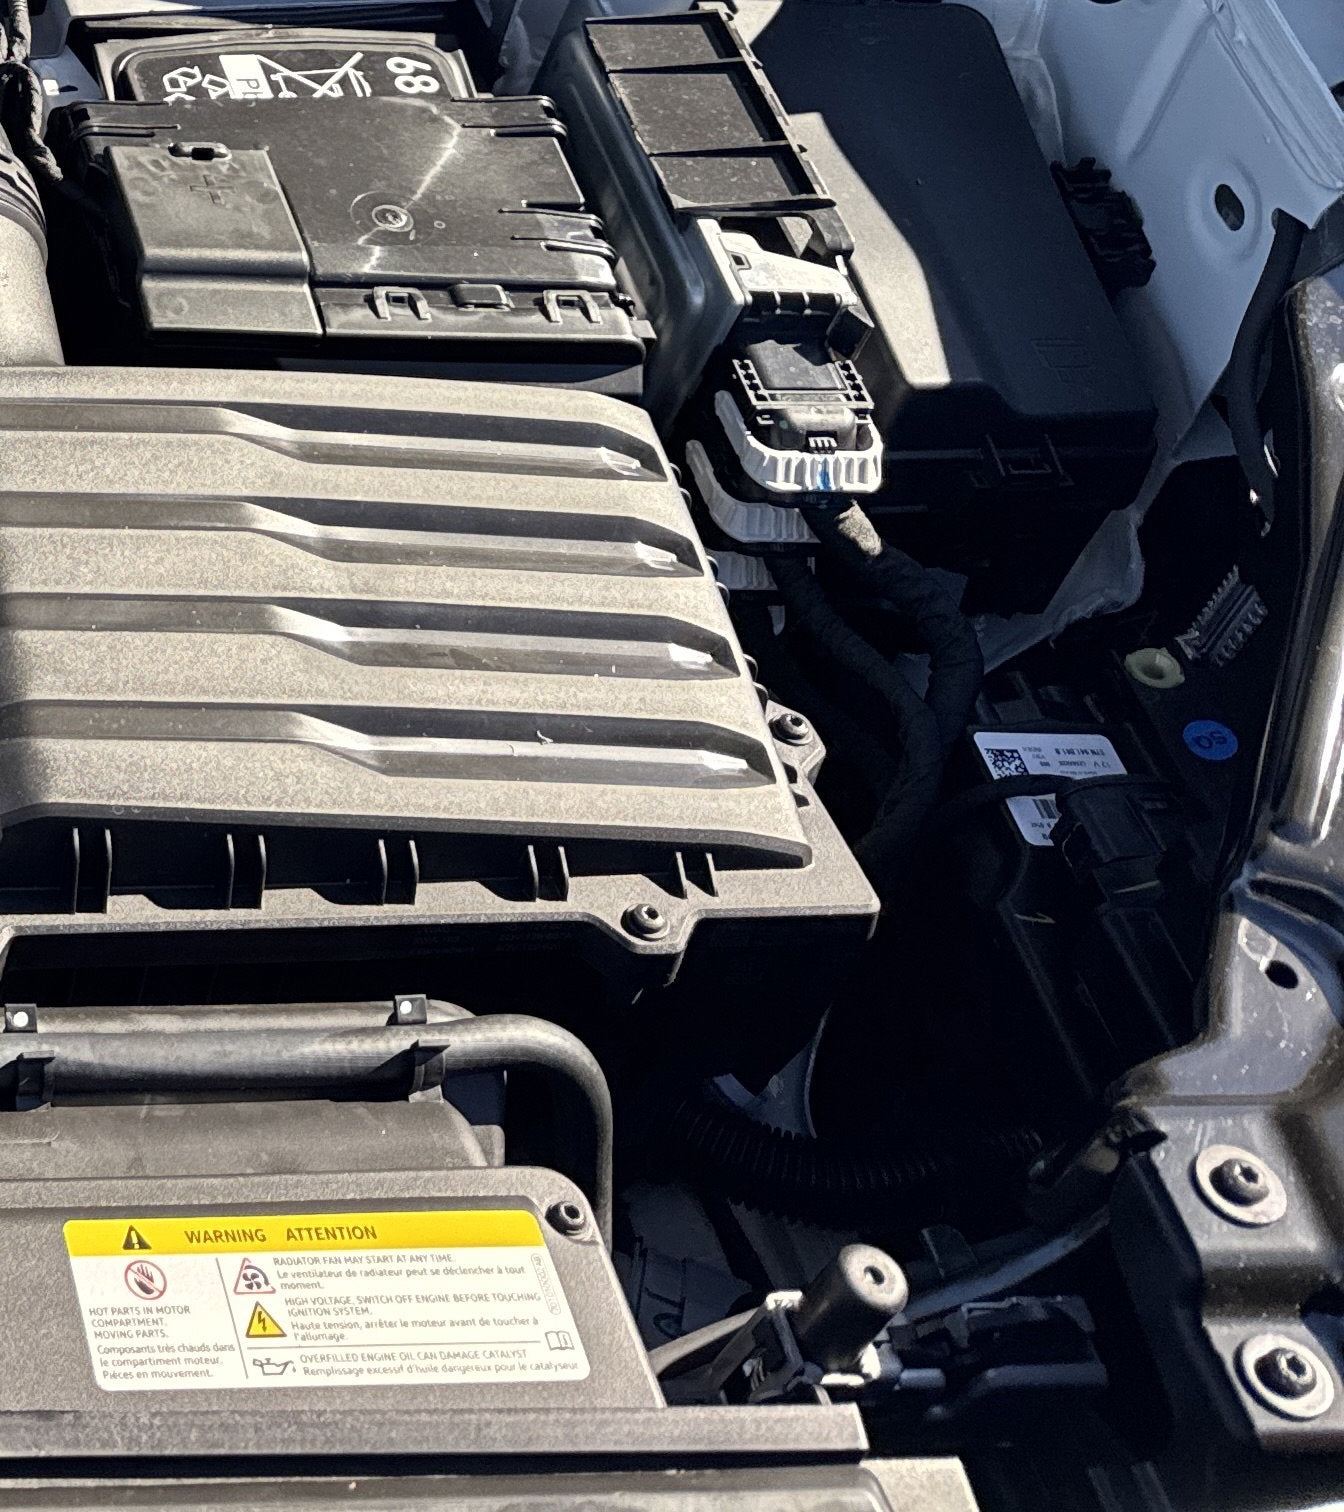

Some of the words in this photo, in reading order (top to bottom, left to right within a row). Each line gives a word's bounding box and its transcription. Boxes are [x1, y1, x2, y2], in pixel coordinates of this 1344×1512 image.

[184, 1226, 267, 1244] WARNING
[286, 1225, 378, 1242] ATTENTION
[273, 1256, 320, 1266] RADIATOR
[322, 1256, 342, 1264] FAN
[344, 1256, 363, 1264] MAY
[366, 1255, 393, 1264] START
[396, 1254, 407, 1263] AT
[409, 1254, 428, 1263] ANY
[277, 1270, 288, 1278] Le
[292, 1269, 342, 1278] ventilateur
[345, 1269, 357, 1278] de
[360, 1268, 402, 1278] radiateur
[406, 1267, 427, 1277] peut
[443, 1266, 494, 1275] déclencher
[497, 1266, 503, 1274] à
[505, 1266, 526, 1274] tout
[280, 1281, 324, 1290] moment.
[285, 1297, 309, 1306] HIGH
[356, 1295, 392, 1304] SWITCH
[395, 1295, 413, 1304] OFF
[416, 1295, 450, 1304] ENGINE
[453, 1293, 490, 1303] BEFORE
[492, 1292, 541, 1302] TOUCHING
[89, 1307, 109, 1316] HOT
[112, 1306, 141, 1315] PARTS
[143, 1306, 154, 1315] IN
[156, 1305, 191, 1315] MOTOR
[288, 1308, 331, 1317] IGNITION
[333, 1307, 373, 1316] SYSTEM.
[91, 1317, 168, 1328] COMPARTMENT.
[291, 1322, 321, 1330] Haute
[323, 1320, 363, 1330] tension,
[364, 1319, 398, 1329] arrêter
[400, 1320, 409, 1328] le
[411, 1319, 446, 1327] moteur
[449, 1318, 476, 1327] avant
[479, 1317, 491, 1327] de
[493, 1317, 530, 1326] toucher
[533, 1316, 539, 1326] à
[94, 1330, 134, 1339] MOVING
[136, 1329, 169, 1338] PARTS.
[97, 1344, 156, 1356] Composants
[158, 1344, 176, 1353] très
[177, 1343, 211, 1353] chauds
[213, 1343, 236, 1352] dans
[100, 1358, 109, 1367] le
[112, 1357, 181, 1368] compartiment
[184, 1357, 224, 1365] moteur.
[300, 1352, 359, 1364] OVERFILLED
[361, 1352, 397, 1363] ENGINE
[398, 1351, 415, 1362] OIL
[416, 1350, 438, 1361] CAN
[441, 1350, 480, 1360] DAMAGE
[483, 1349, 527, 1360] CATALYST
[103, 1370, 134, 1380] Pièces
[136, 1371, 149, 1379] en
[151, 1369, 213, 1378] mouvement.
[302, 1364, 364, 1377] Remplissage
[366, 1364, 404, 1375] excessif
[406, 1364, 440, 1374] d'huile
[441, 1362, 492, 1376] dangereux
[494, 1363, 516, 1374] pour
[518, 1361, 527, 1371] le
[529, 1360, 579, 1373] catalyseur
